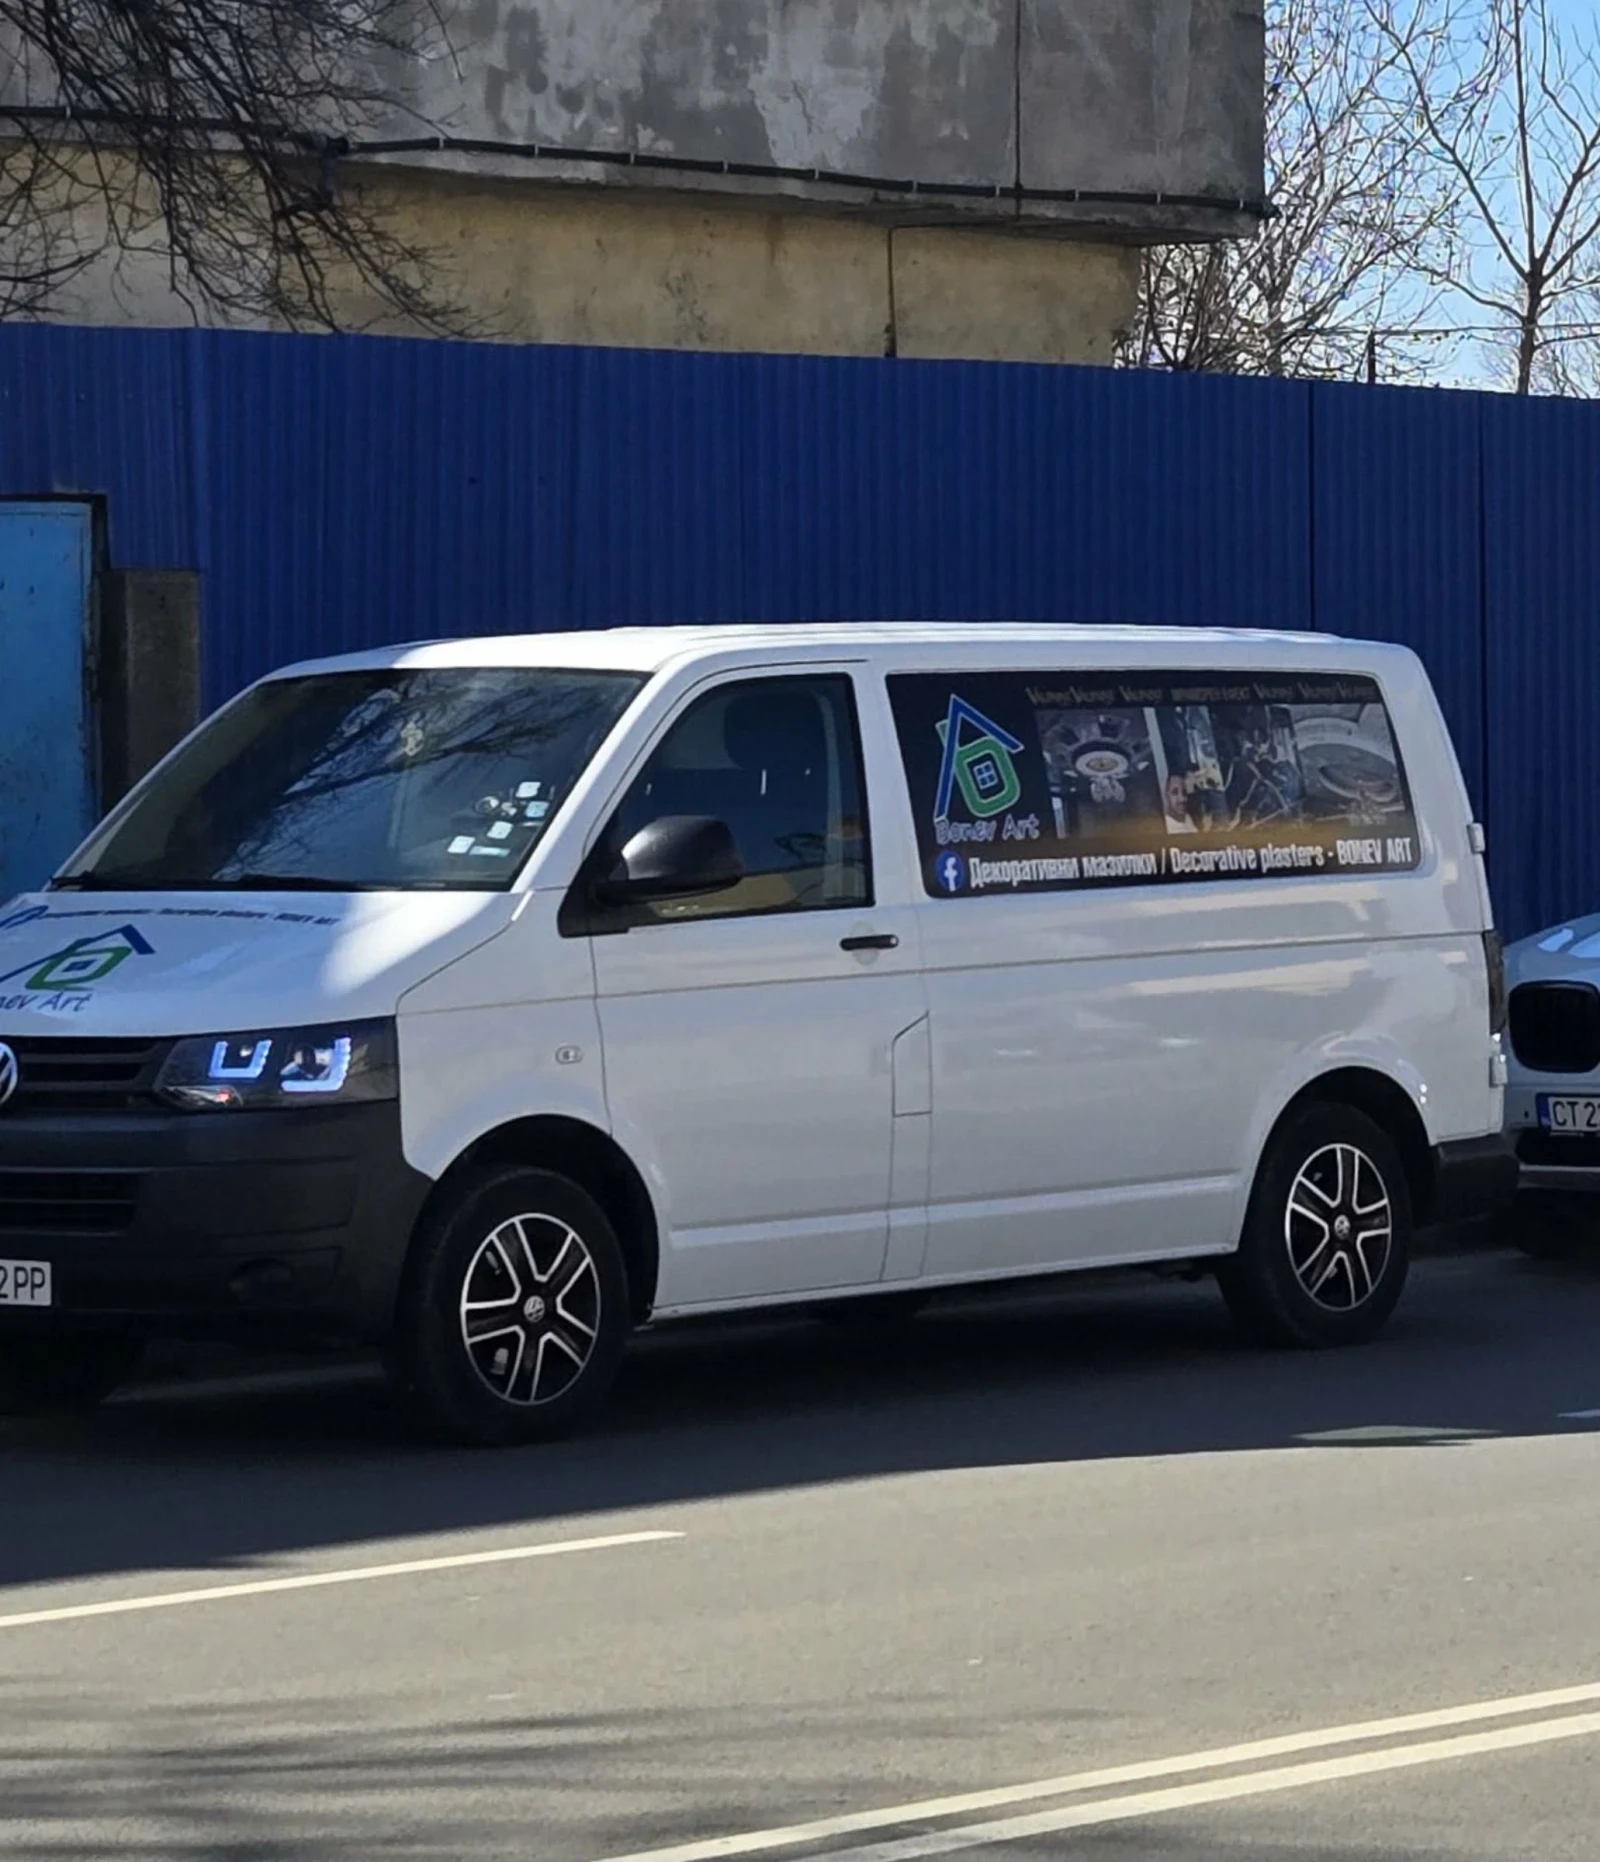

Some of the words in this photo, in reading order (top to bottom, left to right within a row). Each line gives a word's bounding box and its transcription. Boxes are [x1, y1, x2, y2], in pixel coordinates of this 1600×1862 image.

[1002, 813, 1040, 841] Art
[1170, 845, 1257, 873] Decorative
[1260, 842, 1325, 873] plasters
[1386, 837, 1412, 863] ART
